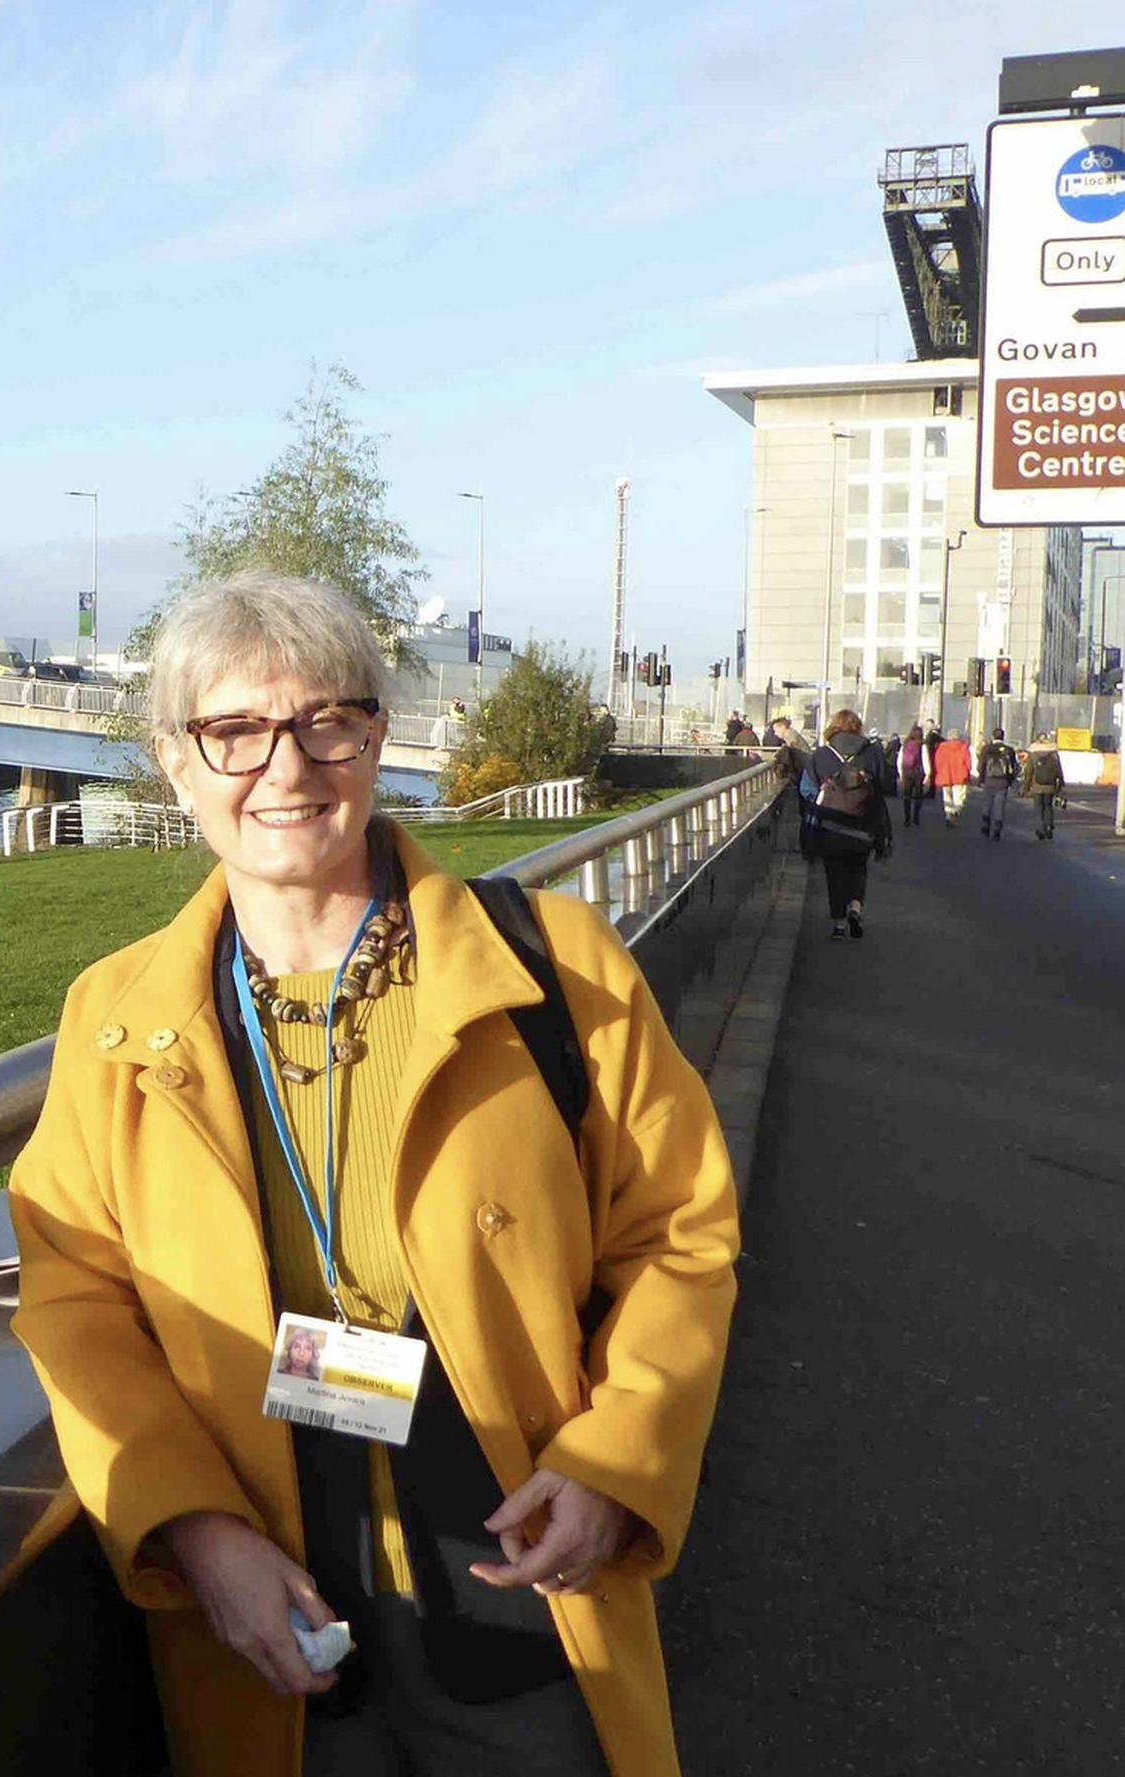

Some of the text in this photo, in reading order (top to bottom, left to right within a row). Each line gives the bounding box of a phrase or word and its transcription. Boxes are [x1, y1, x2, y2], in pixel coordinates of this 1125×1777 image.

[1084, 174, 1118, 187] local
[1056, 250, 1116, 272] Only
[997, 337, 1097, 361] Govan
[1005, 386, 1125, 417] Glasgo
[1017, 450, 1125, 479] Centre
[343, 1374, 394, 1392] OBSERVER
